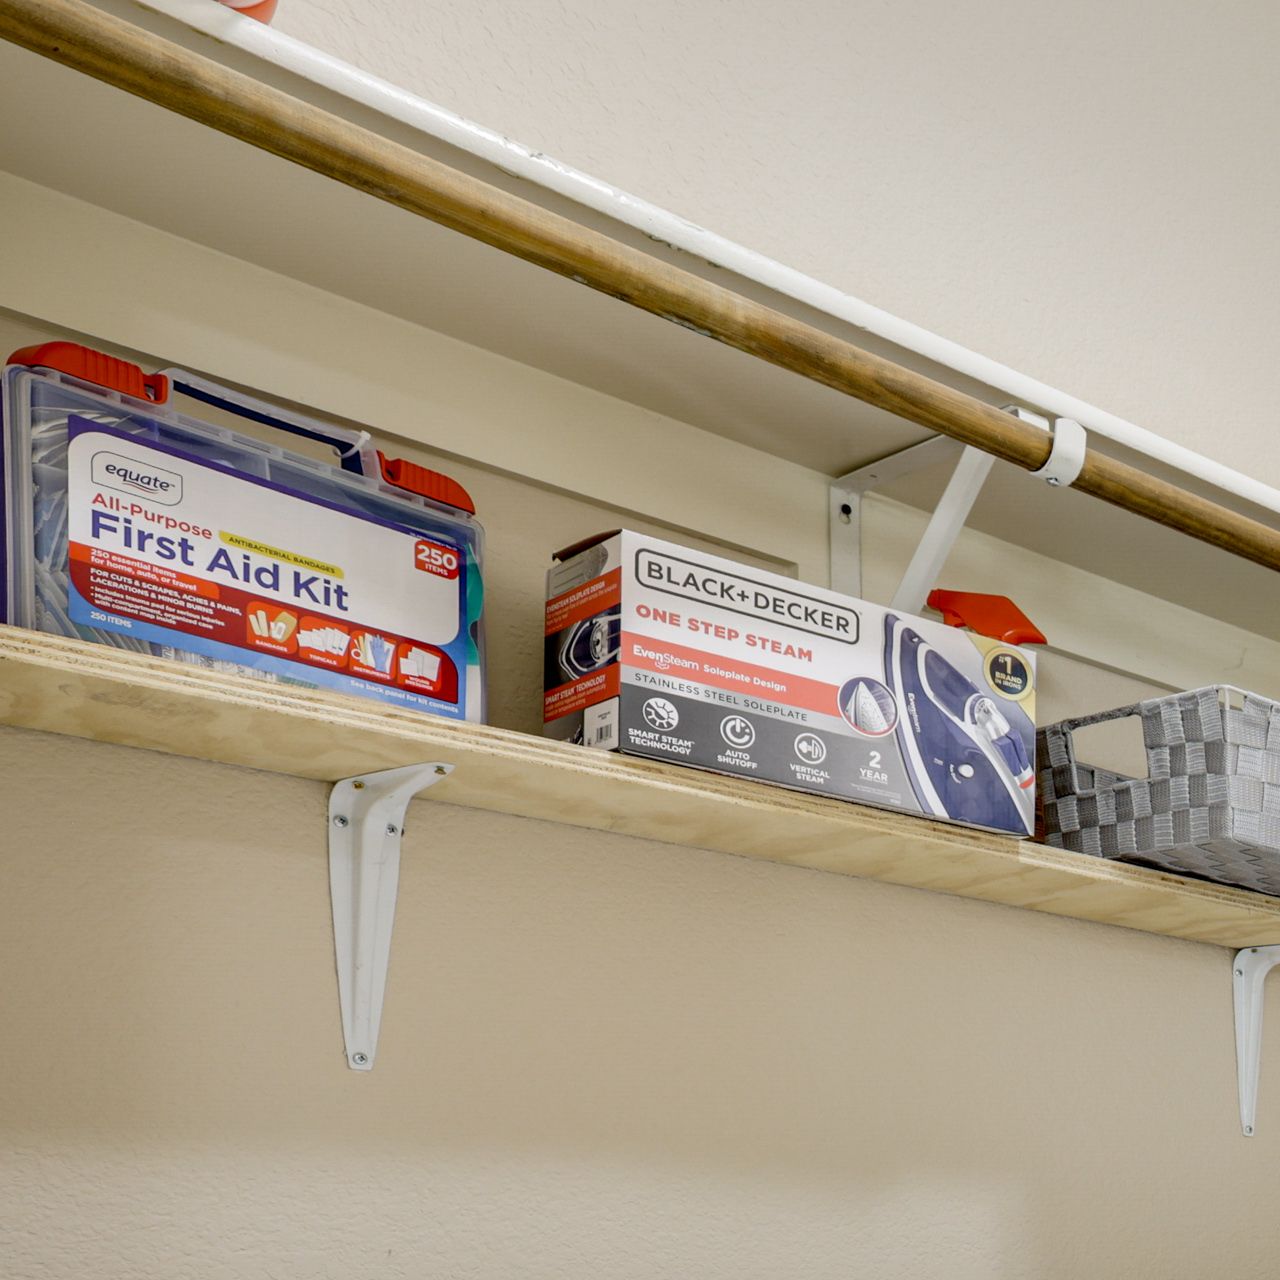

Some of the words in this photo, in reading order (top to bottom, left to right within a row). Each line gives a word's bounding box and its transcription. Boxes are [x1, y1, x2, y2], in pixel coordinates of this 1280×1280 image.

[105, 464, 171, 491] equate
[92, 492, 213, 539] All-Purpose
[91, 509, 194, 567] First
[206, 548, 280, 592] Aid
[293, 570, 349, 612] Kit
[91, 548, 110, 559] 250
[112, 555, 151, 571] essential
[153, 566, 177, 578] items
[229, 536, 292, 561] ANTIBACTERIAL
[293, 556, 336, 574] BANDAGES
[416, 544, 458, 571] 250
[91, 555, 105, 566] for
[106, 559, 135, 575] home,
[137, 569, 159, 582] auto,
[161, 576, 172, 584] or
[172, 578, 197, 591] travel
[425, 563, 449, 576] ITEMS
[90, 567, 109, 578] FOR
[110, 572, 133, 584] CUTS
[134, 579, 141, 587] &
[142, 581, 180, 599] SCRAPES,
[182, 592, 209, 606] ACHES
[210, 600, 216, 608] &
[217, 602, 243, 616] PAINS,
[90, 576, 149, 597] LACERATIONS
[157, 593, 185, 607] MINOR
[186, 601, 214, 615] BURNS
[647, 560, 850, 634] BLACK+DECKER
[90, 611, 107, 622] 250
[107, 615, 132, 629] ITEMS
[635, 604, 681, 628] ONE
[687, 617, 739, 642] STEP
[745, 633, 813, 663] STEAM
[632, 644, 699, 671] EvenSteam
[703, 664, 751, 683] Soleplate
[752, 676, 787, 692] Design
[995, 671, 1023, 685] BRAND
[998, 655, 1012, 675] #1
[350, 679, 365, 690] See
[365, 683, 384, 695] back
[385, 688, 405, 700] panel
[406, 692, 417, 701] for
[417, 695, 428, 704] kit
[428, 698, 459, 713] contents
[634, 672, 700, 696] STAINLESS
[704, 689, 740, 705] STEEL
[743, 699, 808, 722] SOLEPLATE
[1002, 680, 1022, 690] IRONS
[627, 727, 660, 741] SMART
[661, 735, 692, 748] STEAM
[629, 735, 692, 756] TECHNOLOGY
[717, 755, 758, 769] SHUTOFF
[725, 749, 750, 760] AUTO
[868, 750, 881, 769] 2
[789, 763, 831, 779] VERTICAL
[796, 773, 824, 785] STEAM
[859, 767, 889, 782] YEAR
